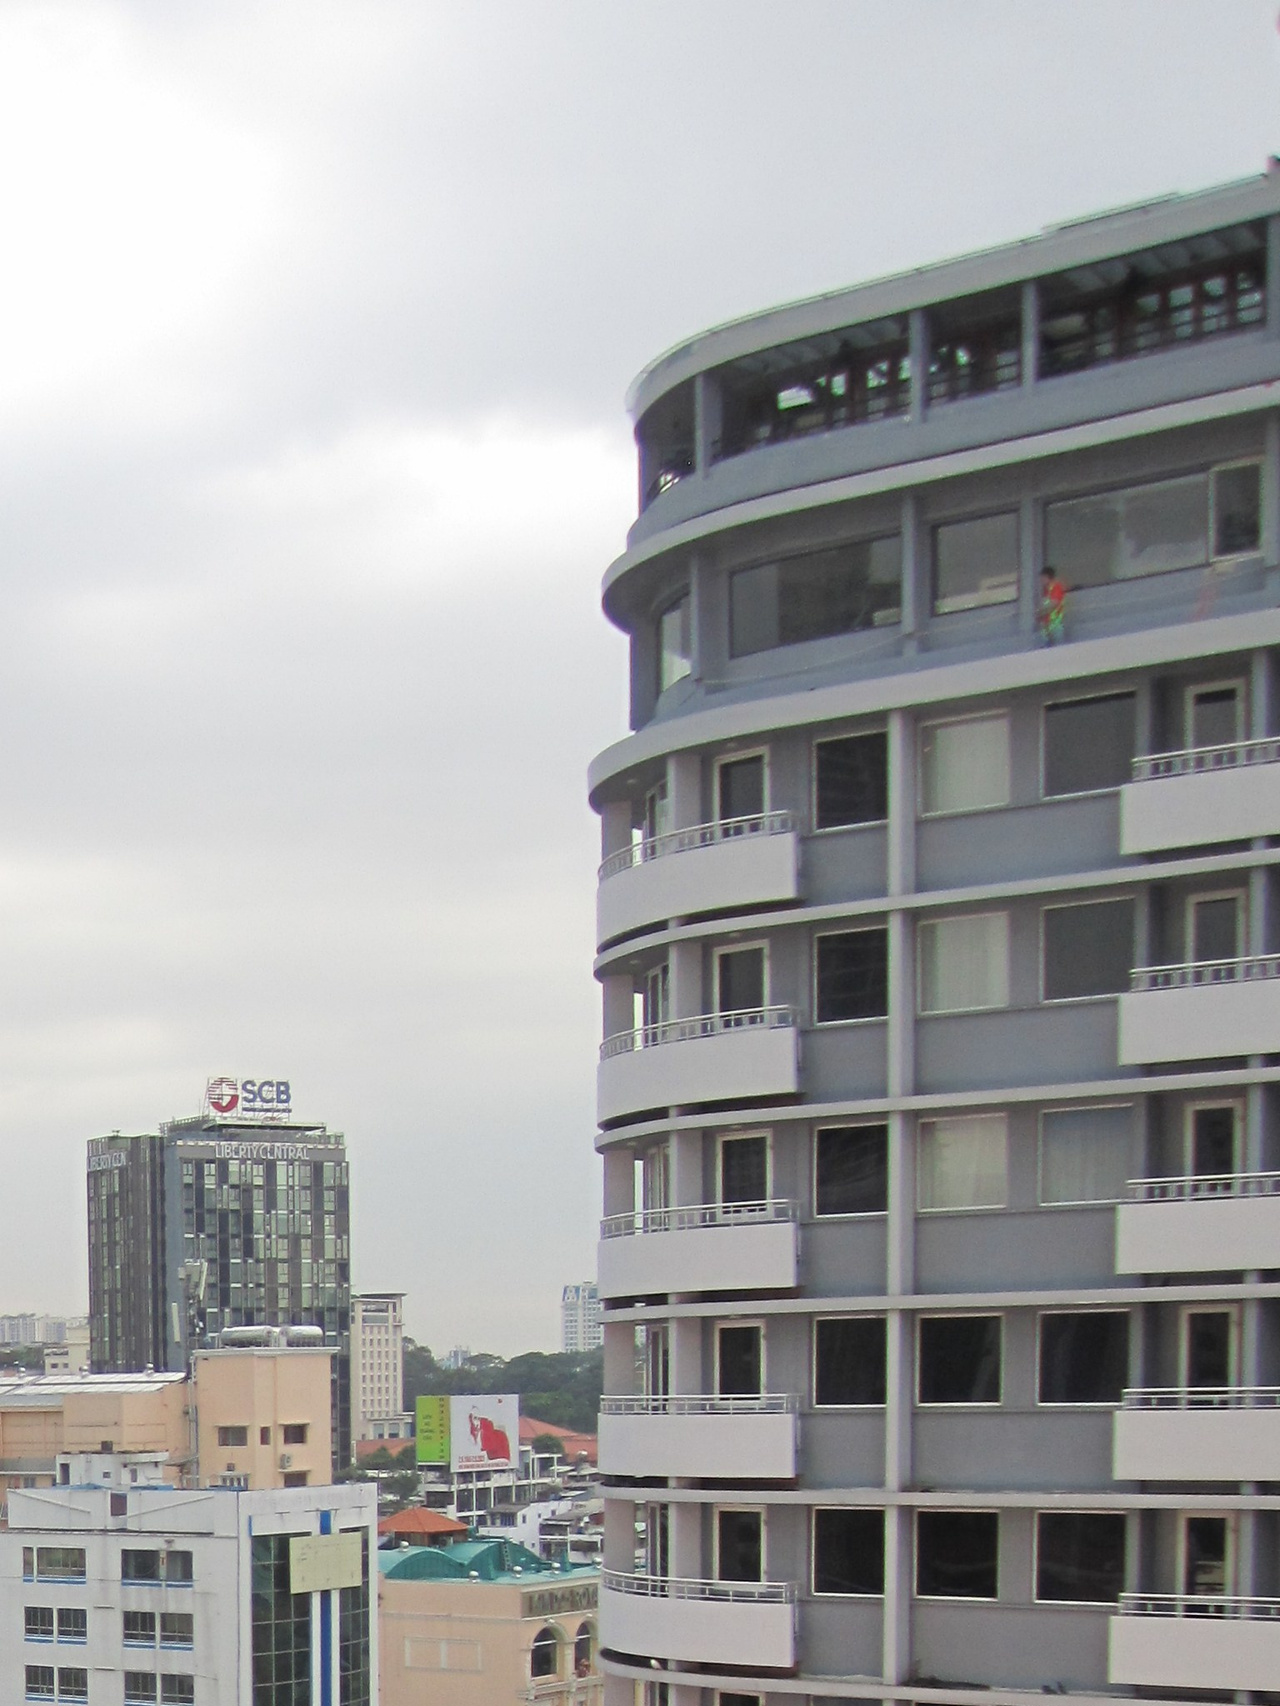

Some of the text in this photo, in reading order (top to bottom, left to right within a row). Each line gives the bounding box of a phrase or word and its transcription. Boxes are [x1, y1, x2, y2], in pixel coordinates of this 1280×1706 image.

[241, 1080, 292, 1104] SCB
[215, 1144, 310, 1160] LIBERTY CENTRAL
